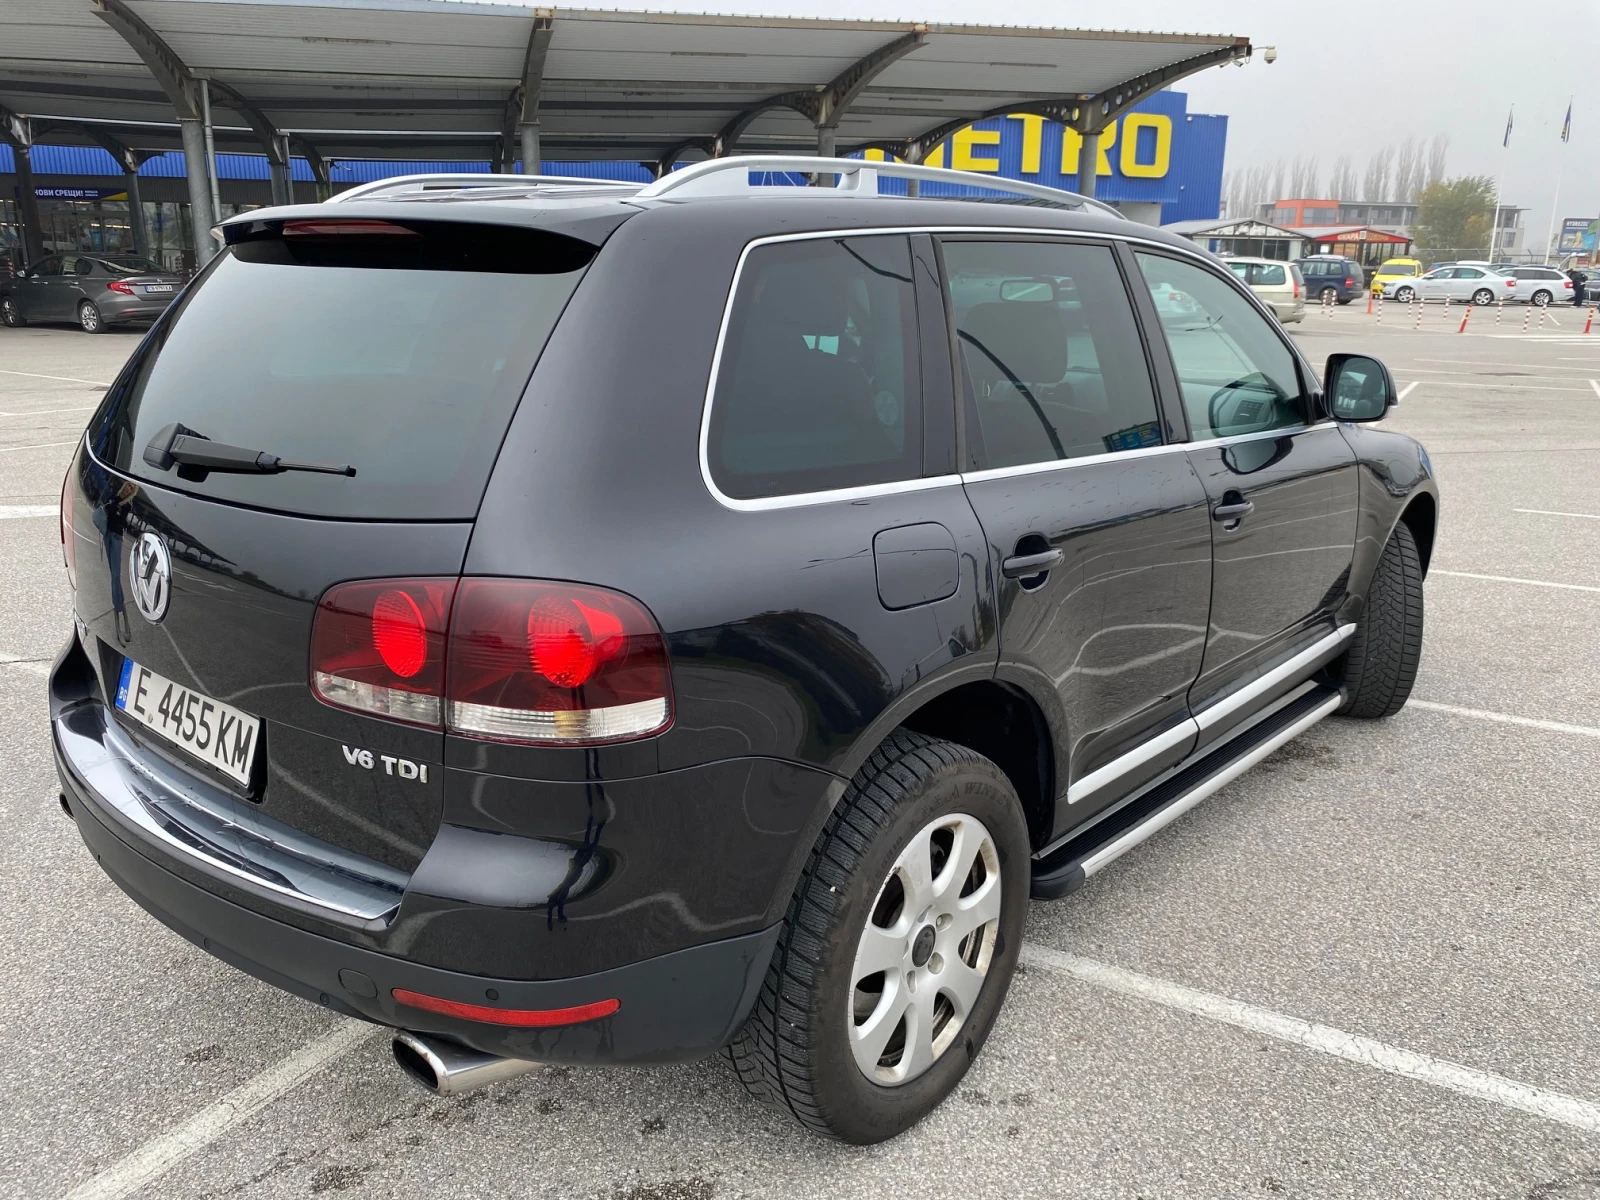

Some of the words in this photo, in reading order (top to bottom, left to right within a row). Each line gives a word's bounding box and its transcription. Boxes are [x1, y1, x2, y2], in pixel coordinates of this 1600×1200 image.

[55, 189, 83, 197] СРЕЩИ!
[134, 667, 151, 716] E
[158, 683, 214, 750] 4455
[214, 711, 253, 774] KM
[342, 745, 375, 769] V6
[381, 755, 428, 783] TDI
